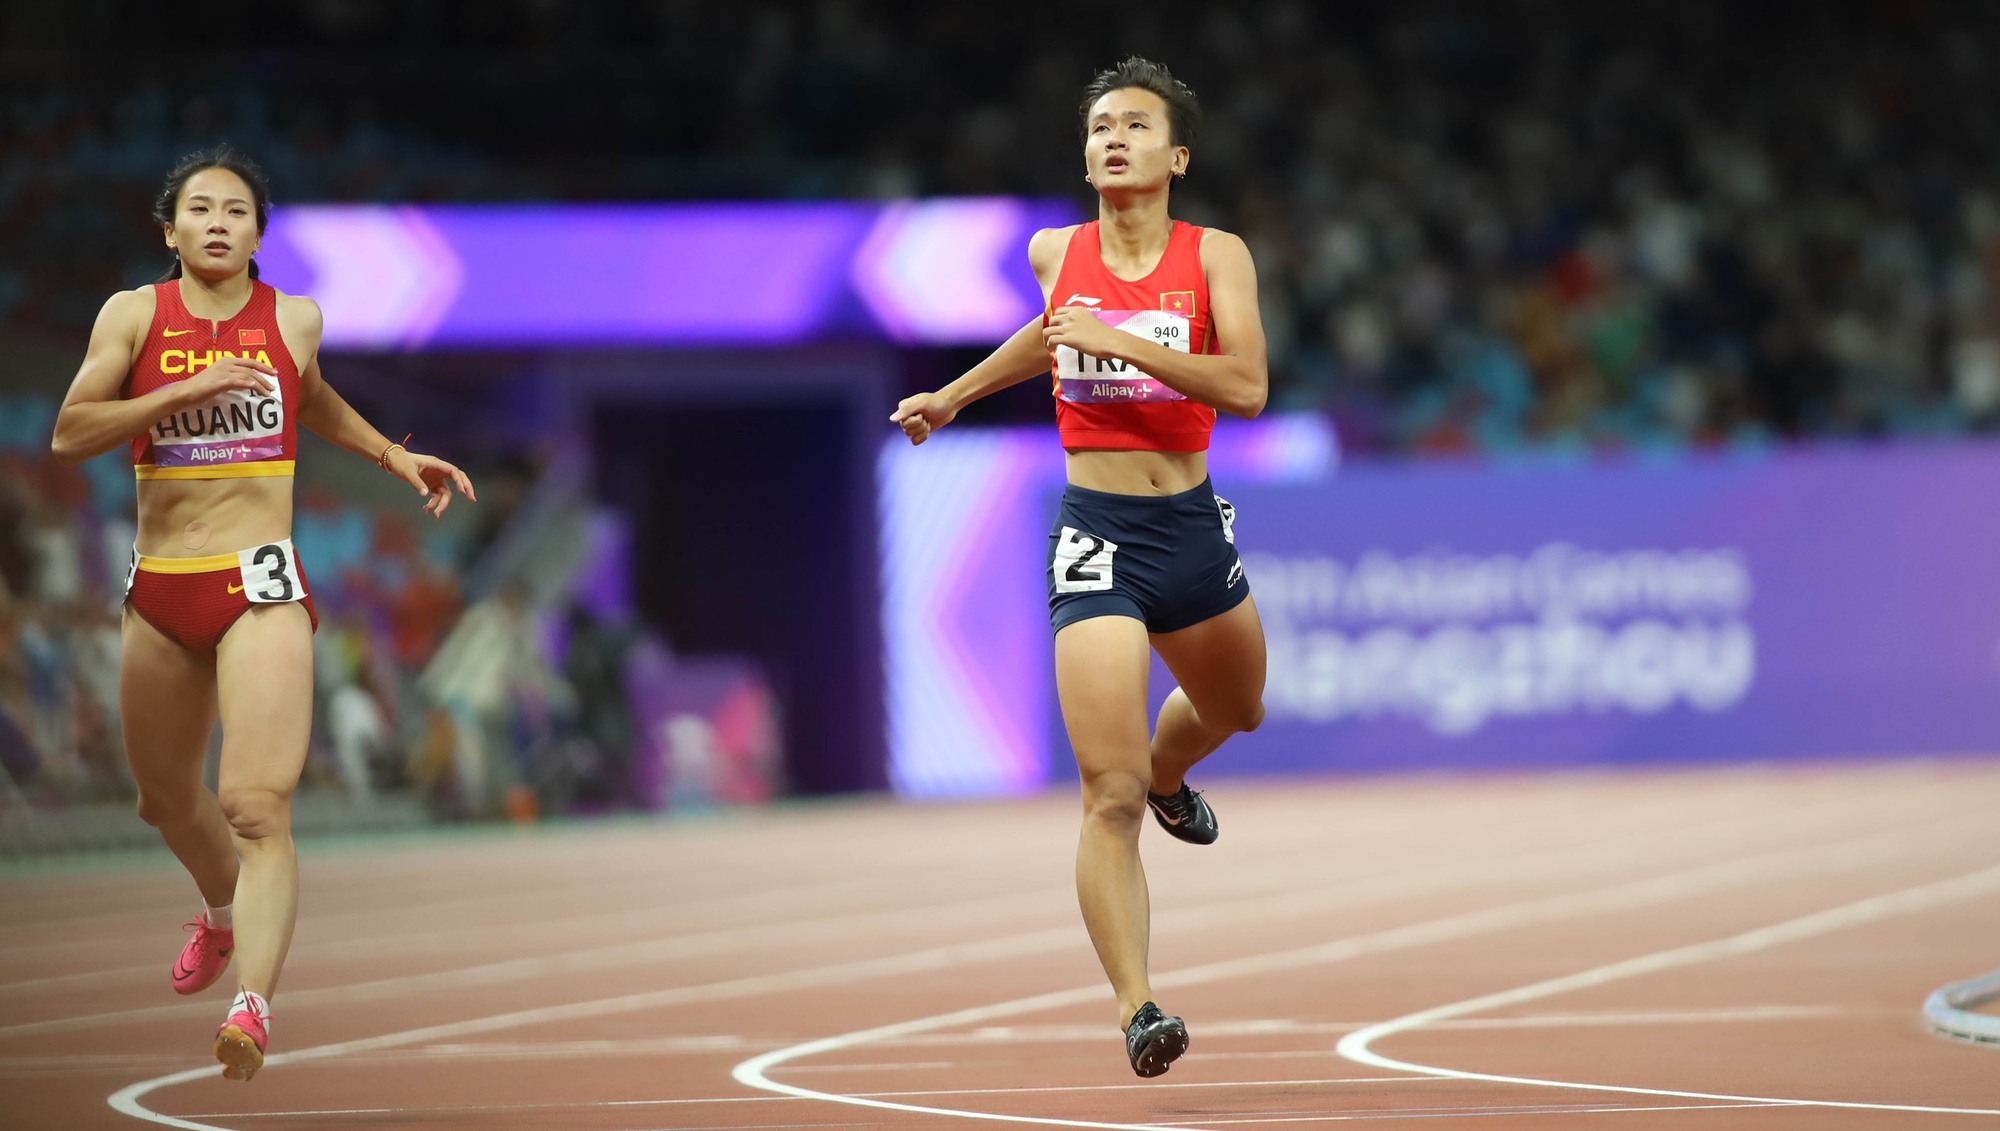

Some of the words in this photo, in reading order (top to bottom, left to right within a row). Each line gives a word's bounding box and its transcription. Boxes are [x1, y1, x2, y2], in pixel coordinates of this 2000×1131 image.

[1154, 326, 1179, 338] 940
[1091, 383, 1135, 398] Alipay
[156, 398, 278, 438] HUANG
[190, 446, 234, 461] Alipay
[1065, 531, 1104, 582] 2
[253, 544, 292, 601] 3
